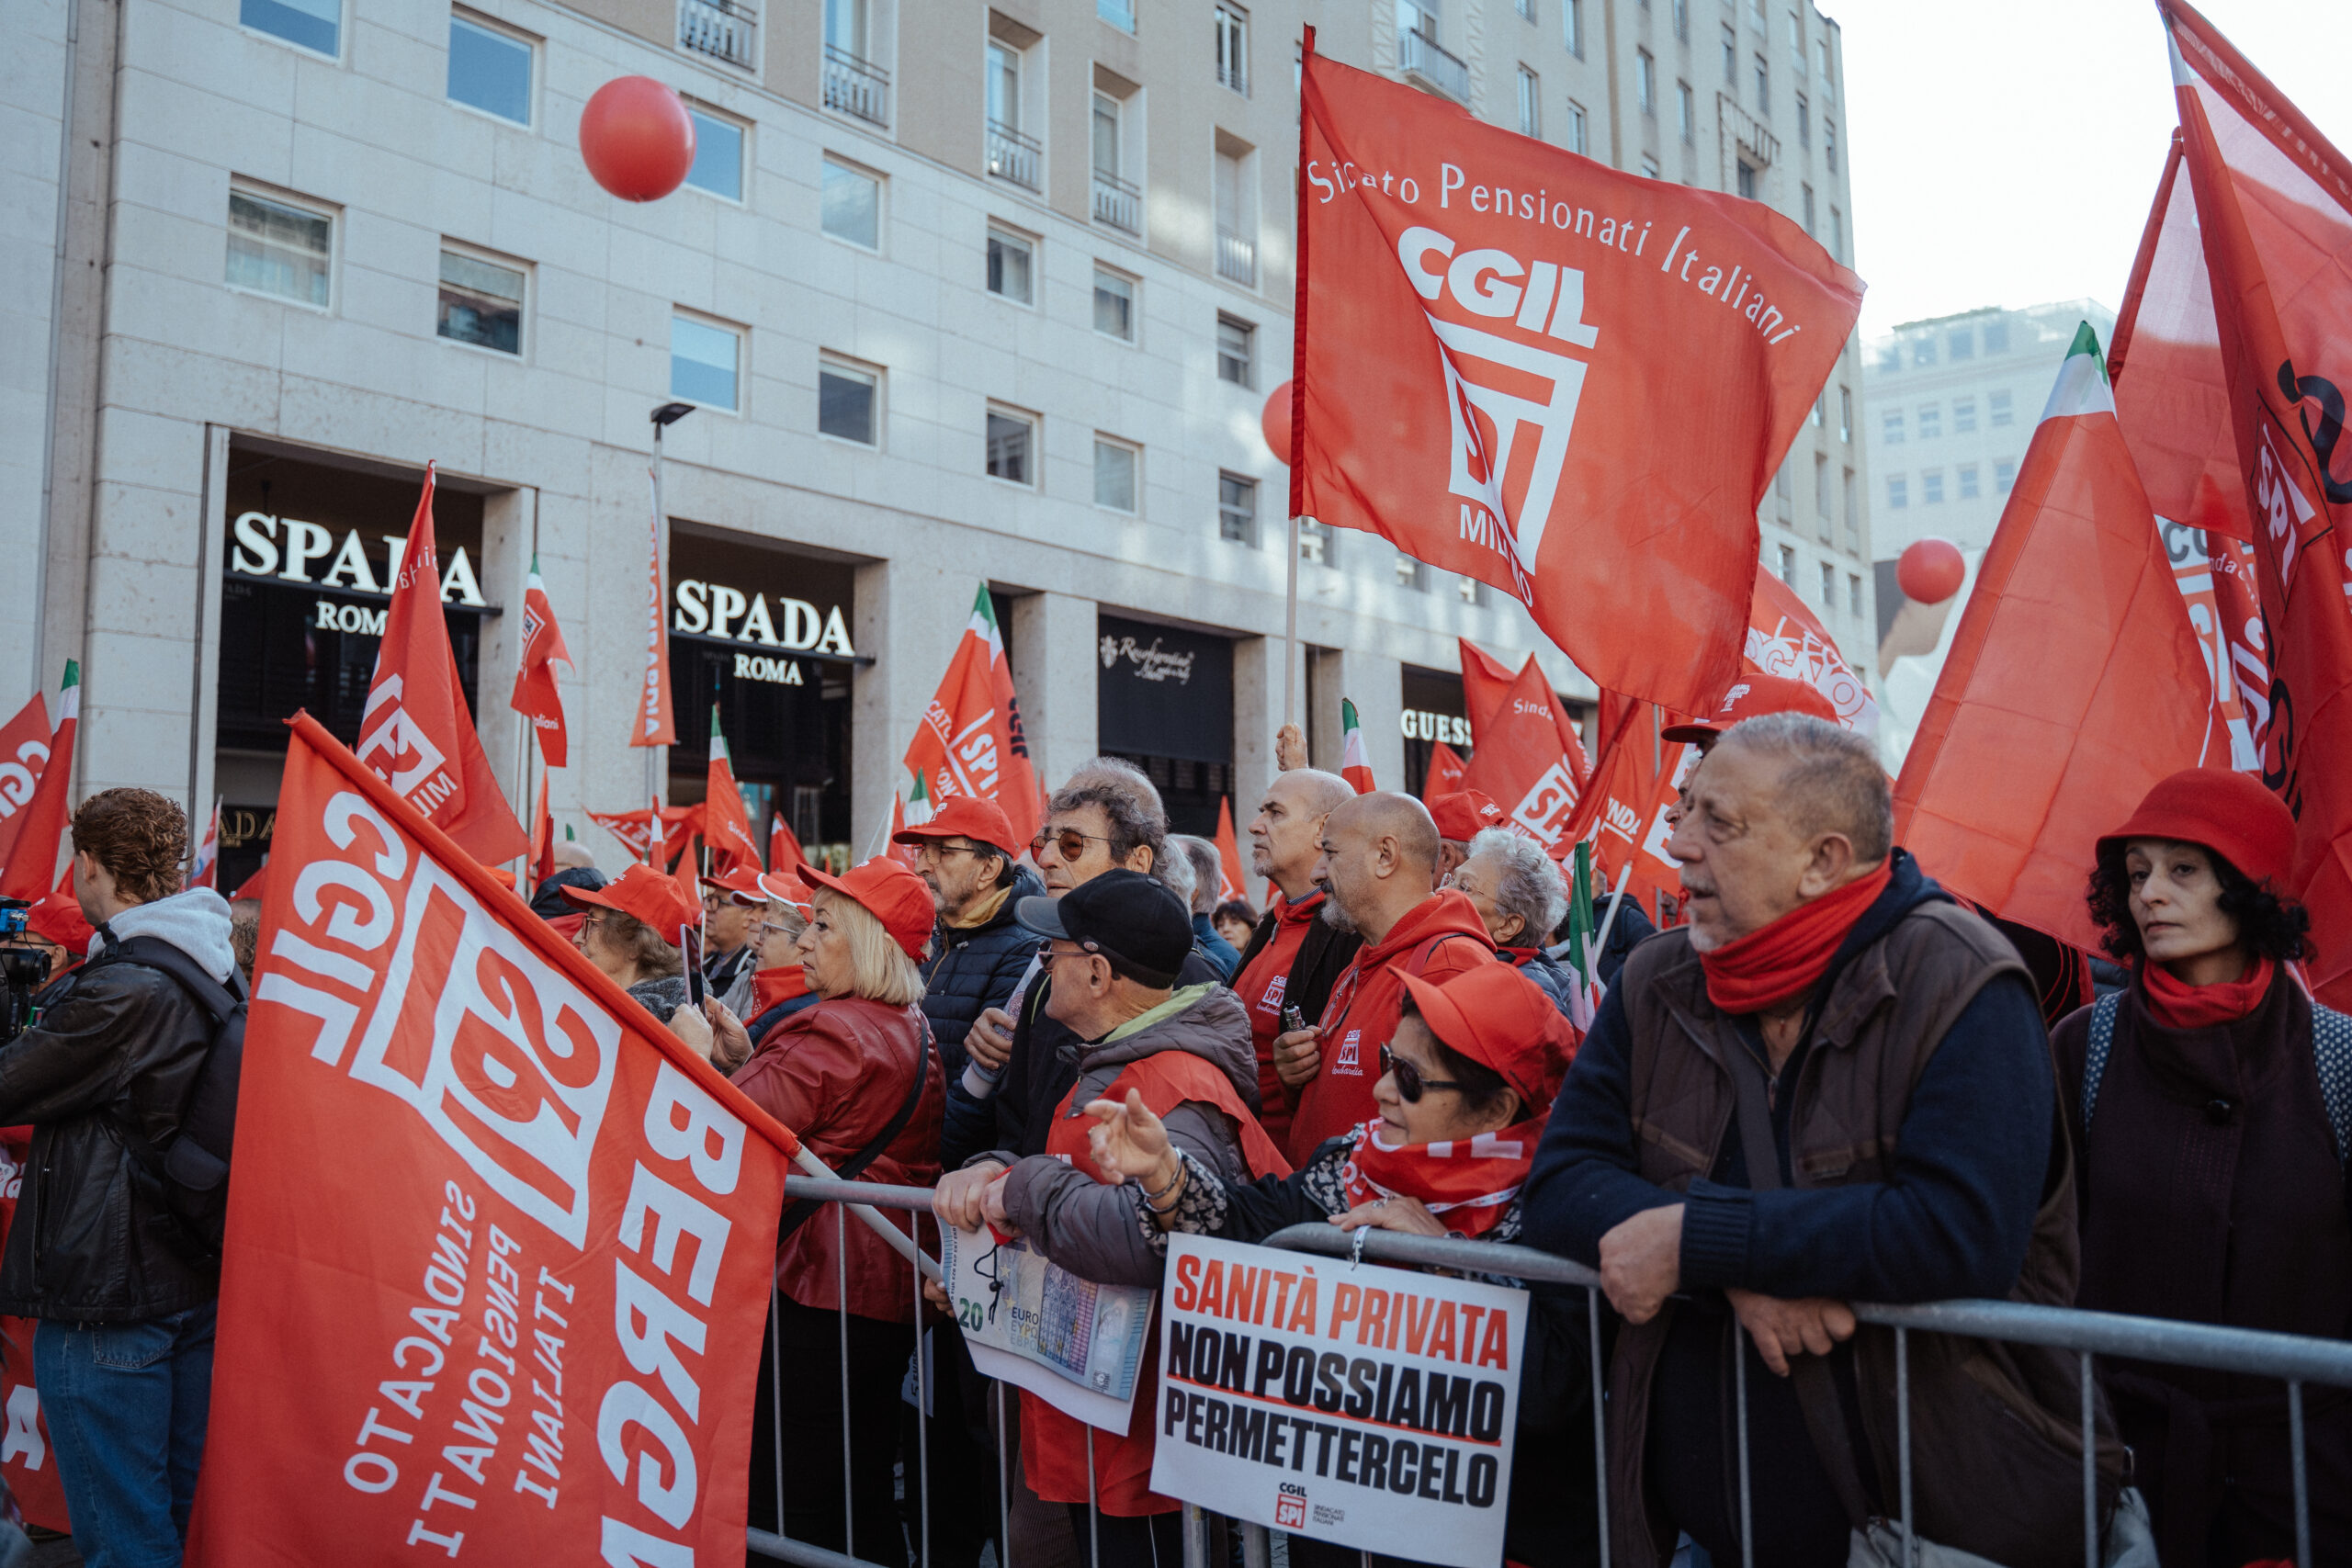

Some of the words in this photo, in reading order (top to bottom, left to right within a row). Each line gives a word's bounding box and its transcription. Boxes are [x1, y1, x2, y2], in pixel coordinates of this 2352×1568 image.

[1440, 163, 1652, 256] Pensionati
[1661, 226, 1801, 345] Italiani
[1397, 226, 1600, 349] CGIL
[315, 601, 390, 637] ROM
[674, 579, 855, 657] SPADA
[733, 653, 804, 686] ROMA
[960, 733, 999, 791] SPI
[1340, 1046, 1356, 1062] SPI
[959, 1297, 984, 1332] 20
[1012, 1307, 1039, 1325] EURO
[1174, 1253, 1317, 1336] SANITÀ
[1328, 1282, 1509, 1371] PRIVATA
[1168, 1320, 1250, 1393] NON
[1252, 1339, 1505, 1443] POSSIAMO
[1164, 1385, 1498, 1509] PERMETTERCELO
[1279, 1482, 1307, 1498] CGIL
[1278, 1503, 1304, 1526] SPI
